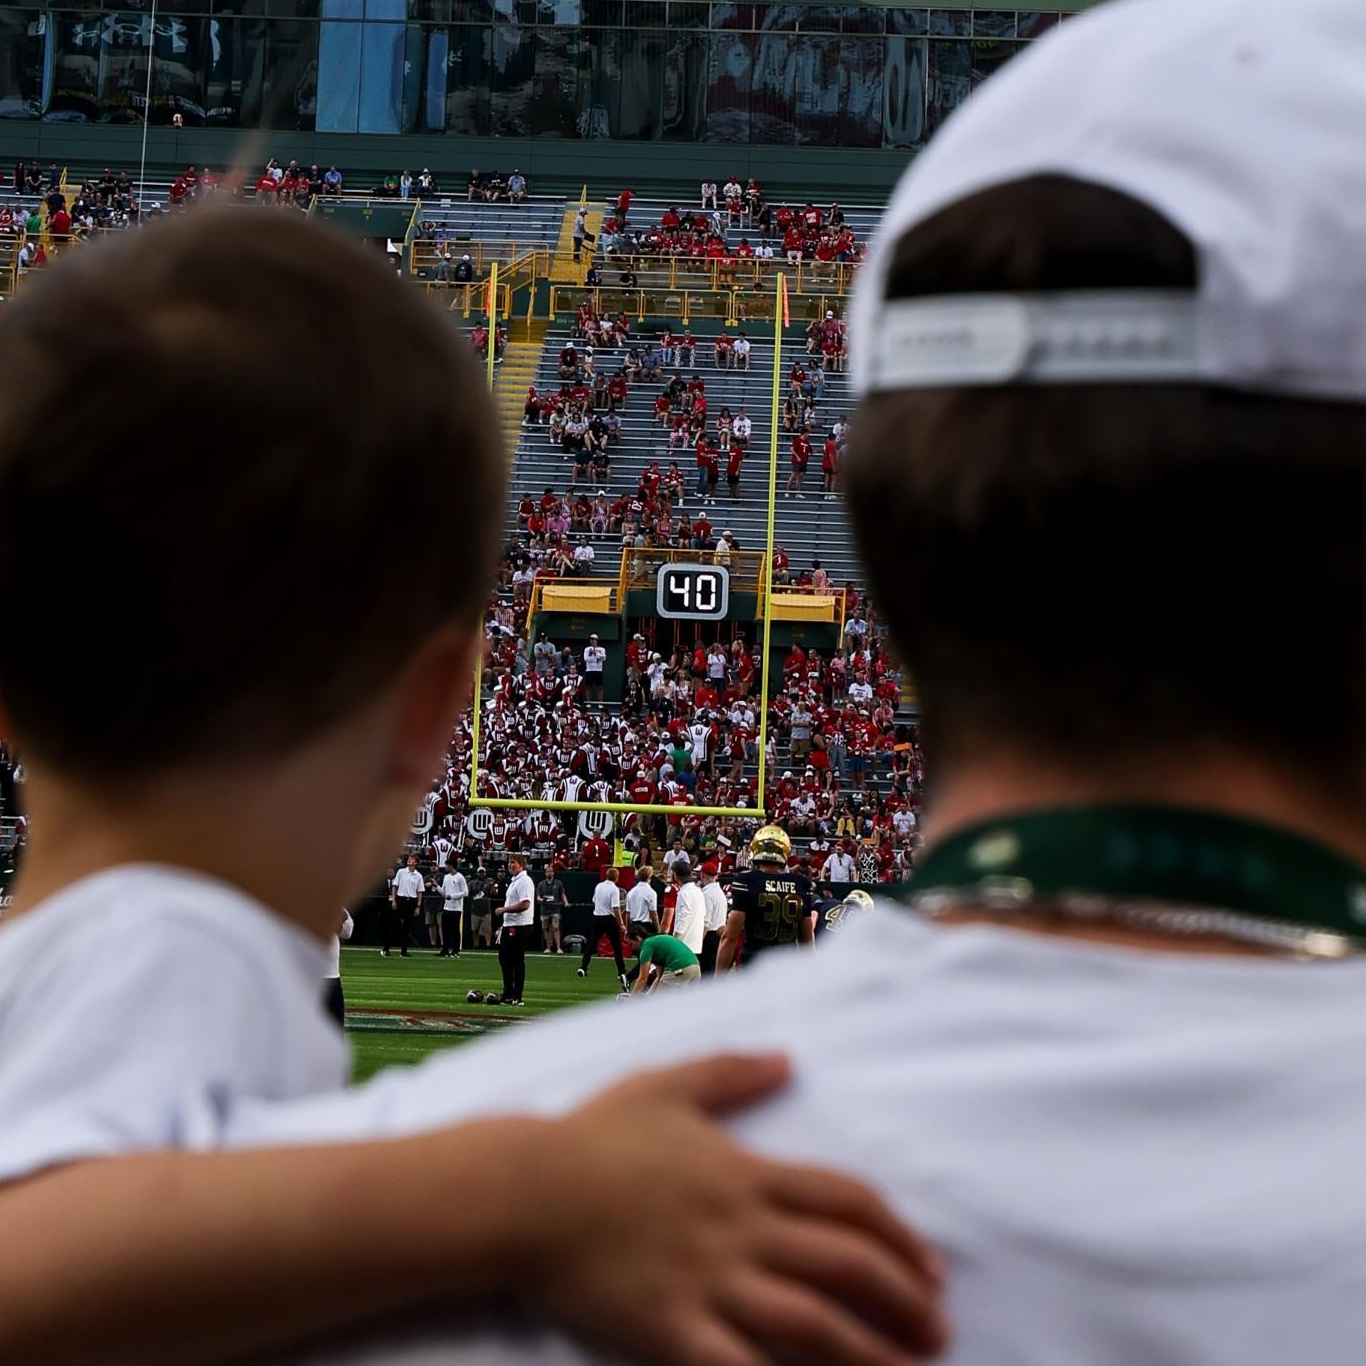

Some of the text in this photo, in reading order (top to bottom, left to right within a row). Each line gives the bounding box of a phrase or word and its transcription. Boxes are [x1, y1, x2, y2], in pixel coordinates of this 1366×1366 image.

[669, 573, 717, 611] 40
[764, 879, 797, 894] SCAIFE
[754, 893, 803, 941] 39
